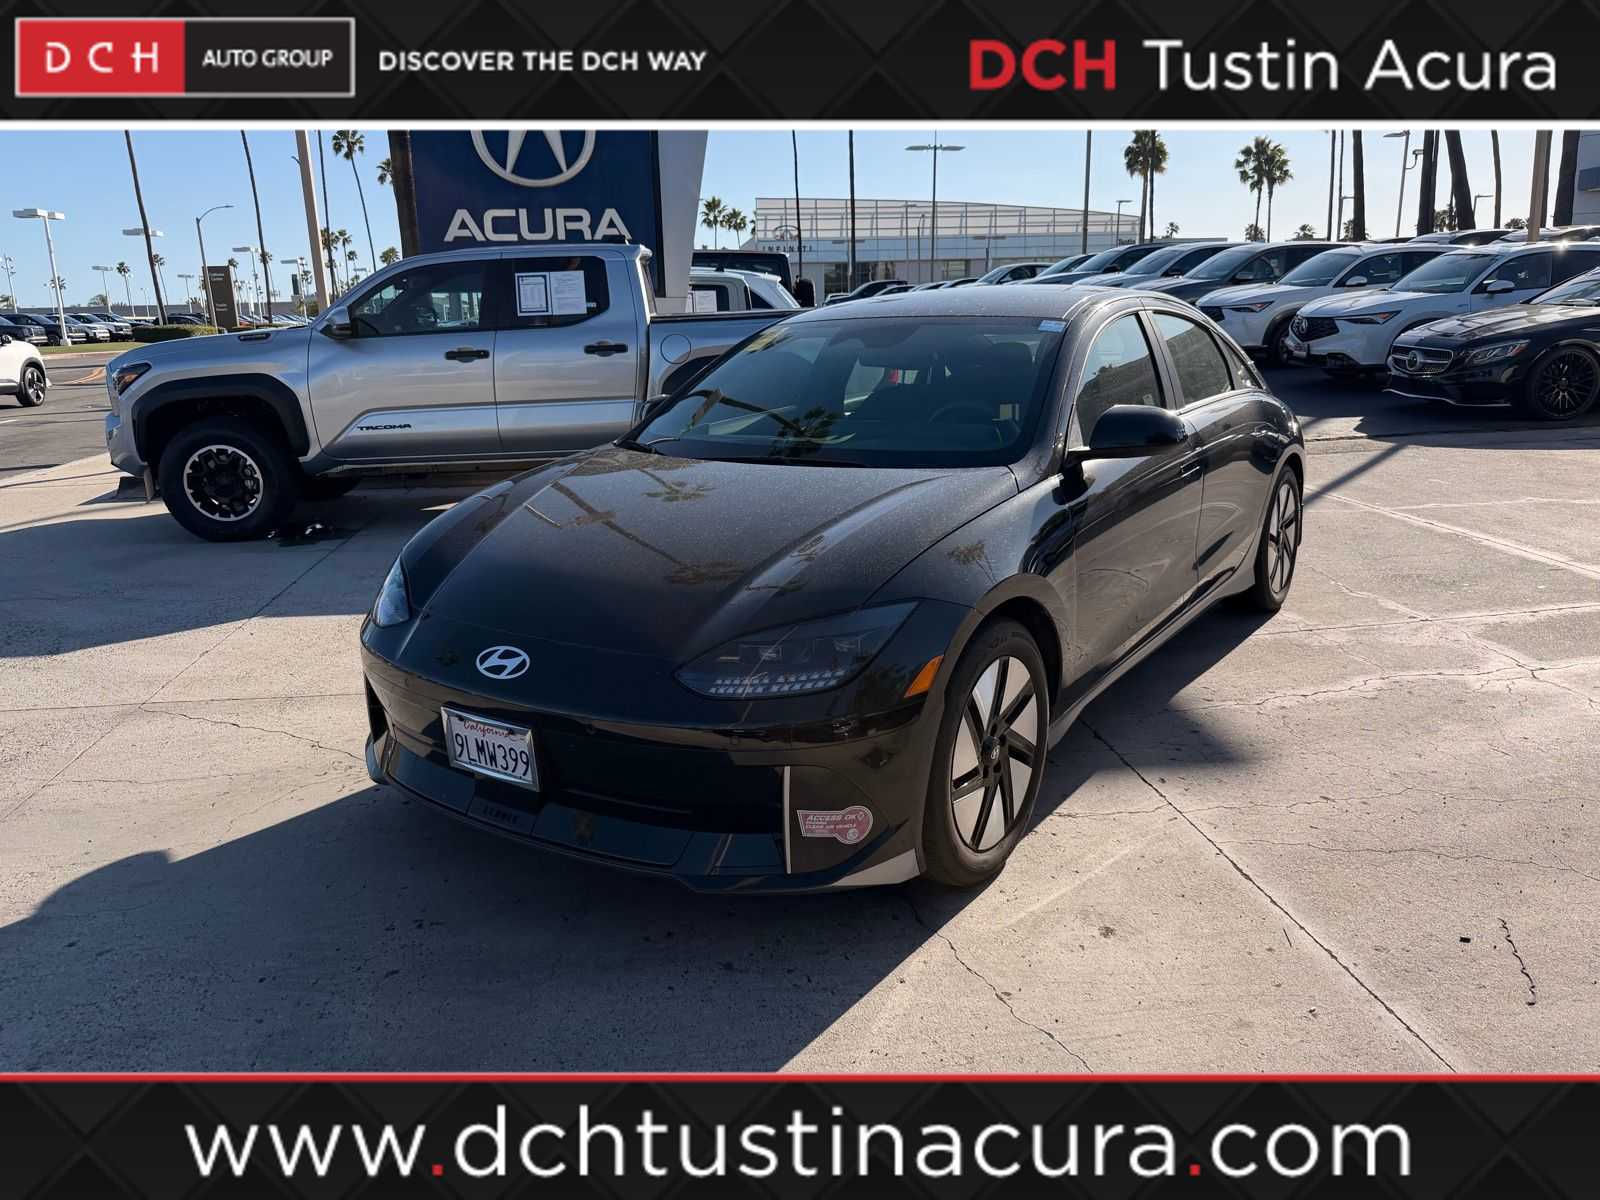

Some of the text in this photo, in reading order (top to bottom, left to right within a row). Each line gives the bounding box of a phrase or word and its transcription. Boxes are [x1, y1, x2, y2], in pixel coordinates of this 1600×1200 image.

[443, 207, 633, 242] ACURA
[762, 245, 812, 253] INFINTI
[357, 423, 412, 431] TACOMA
[454, 733, 530, 776] 9LMW399
